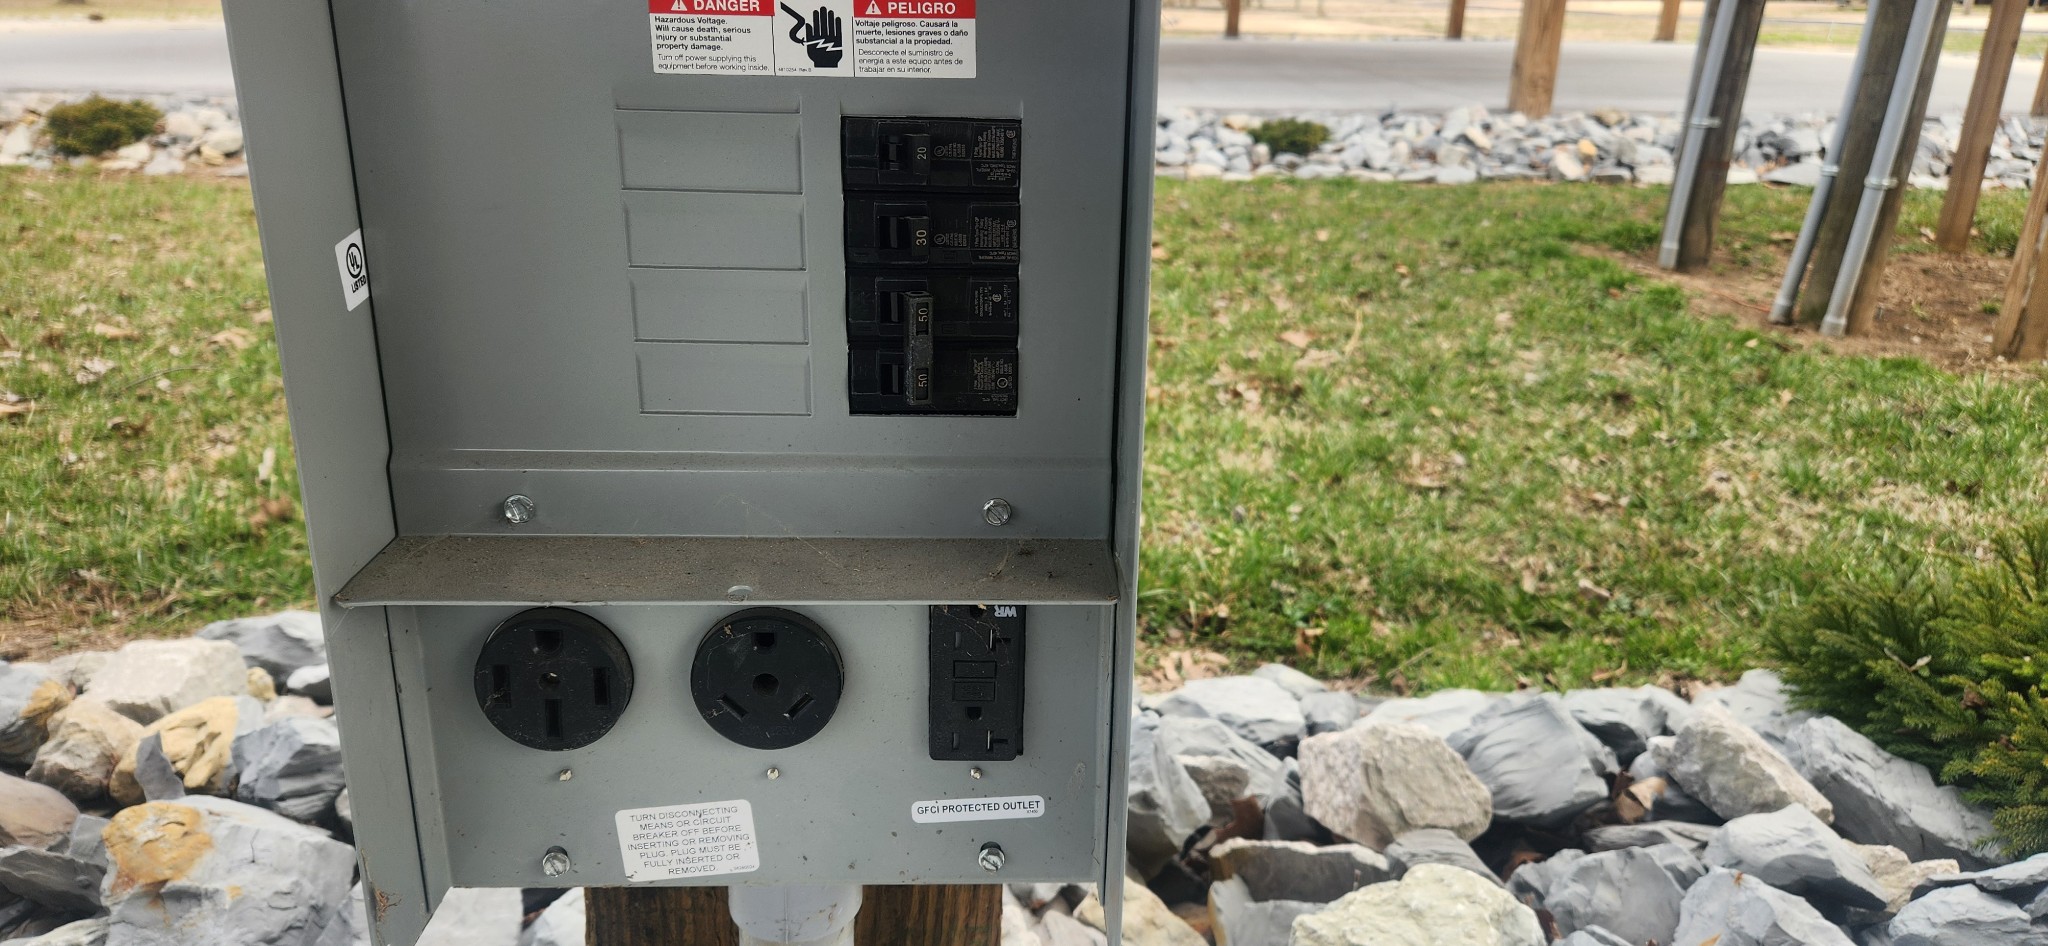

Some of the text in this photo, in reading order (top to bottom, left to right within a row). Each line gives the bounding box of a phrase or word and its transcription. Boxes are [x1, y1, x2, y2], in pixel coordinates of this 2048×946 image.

[694, 0, 760, 12] DANGER
[888, 2, 955, 14] PELIGRO
[882, 20, 917, 29] peligroso.
[917, 146, 926, 160] 20
[916, 230, 927, 246] 30
[351, 274, 366, 294] LISTED
[918, 308, 928, 322] 50
[918, 374, 928, 388] 50
[994, 605, 1017, 618] WR
[630, 806, 738, 822] TURN DISCONNECTING
[943, 802, 1000, 813] PROTECTED
[1003, 801, 1040, 810] OUTLET
[639, 822, 673, 830] MEANS
[693, 816, 731, 826] CIRCUIT
[633, 831, 678, 840] BREAKER
[703, 825, 741, 834] BEFORE
[628, 841, 679, 850] INSERTING
[699, 834, 750, 844] REMOVING
[699, 845, 725, 853] MUST
[644, 859, 672, 868] FULLY
[676, 855, 722, 865] INSERTED
[668, 865, 718, 875] REMOVED.
